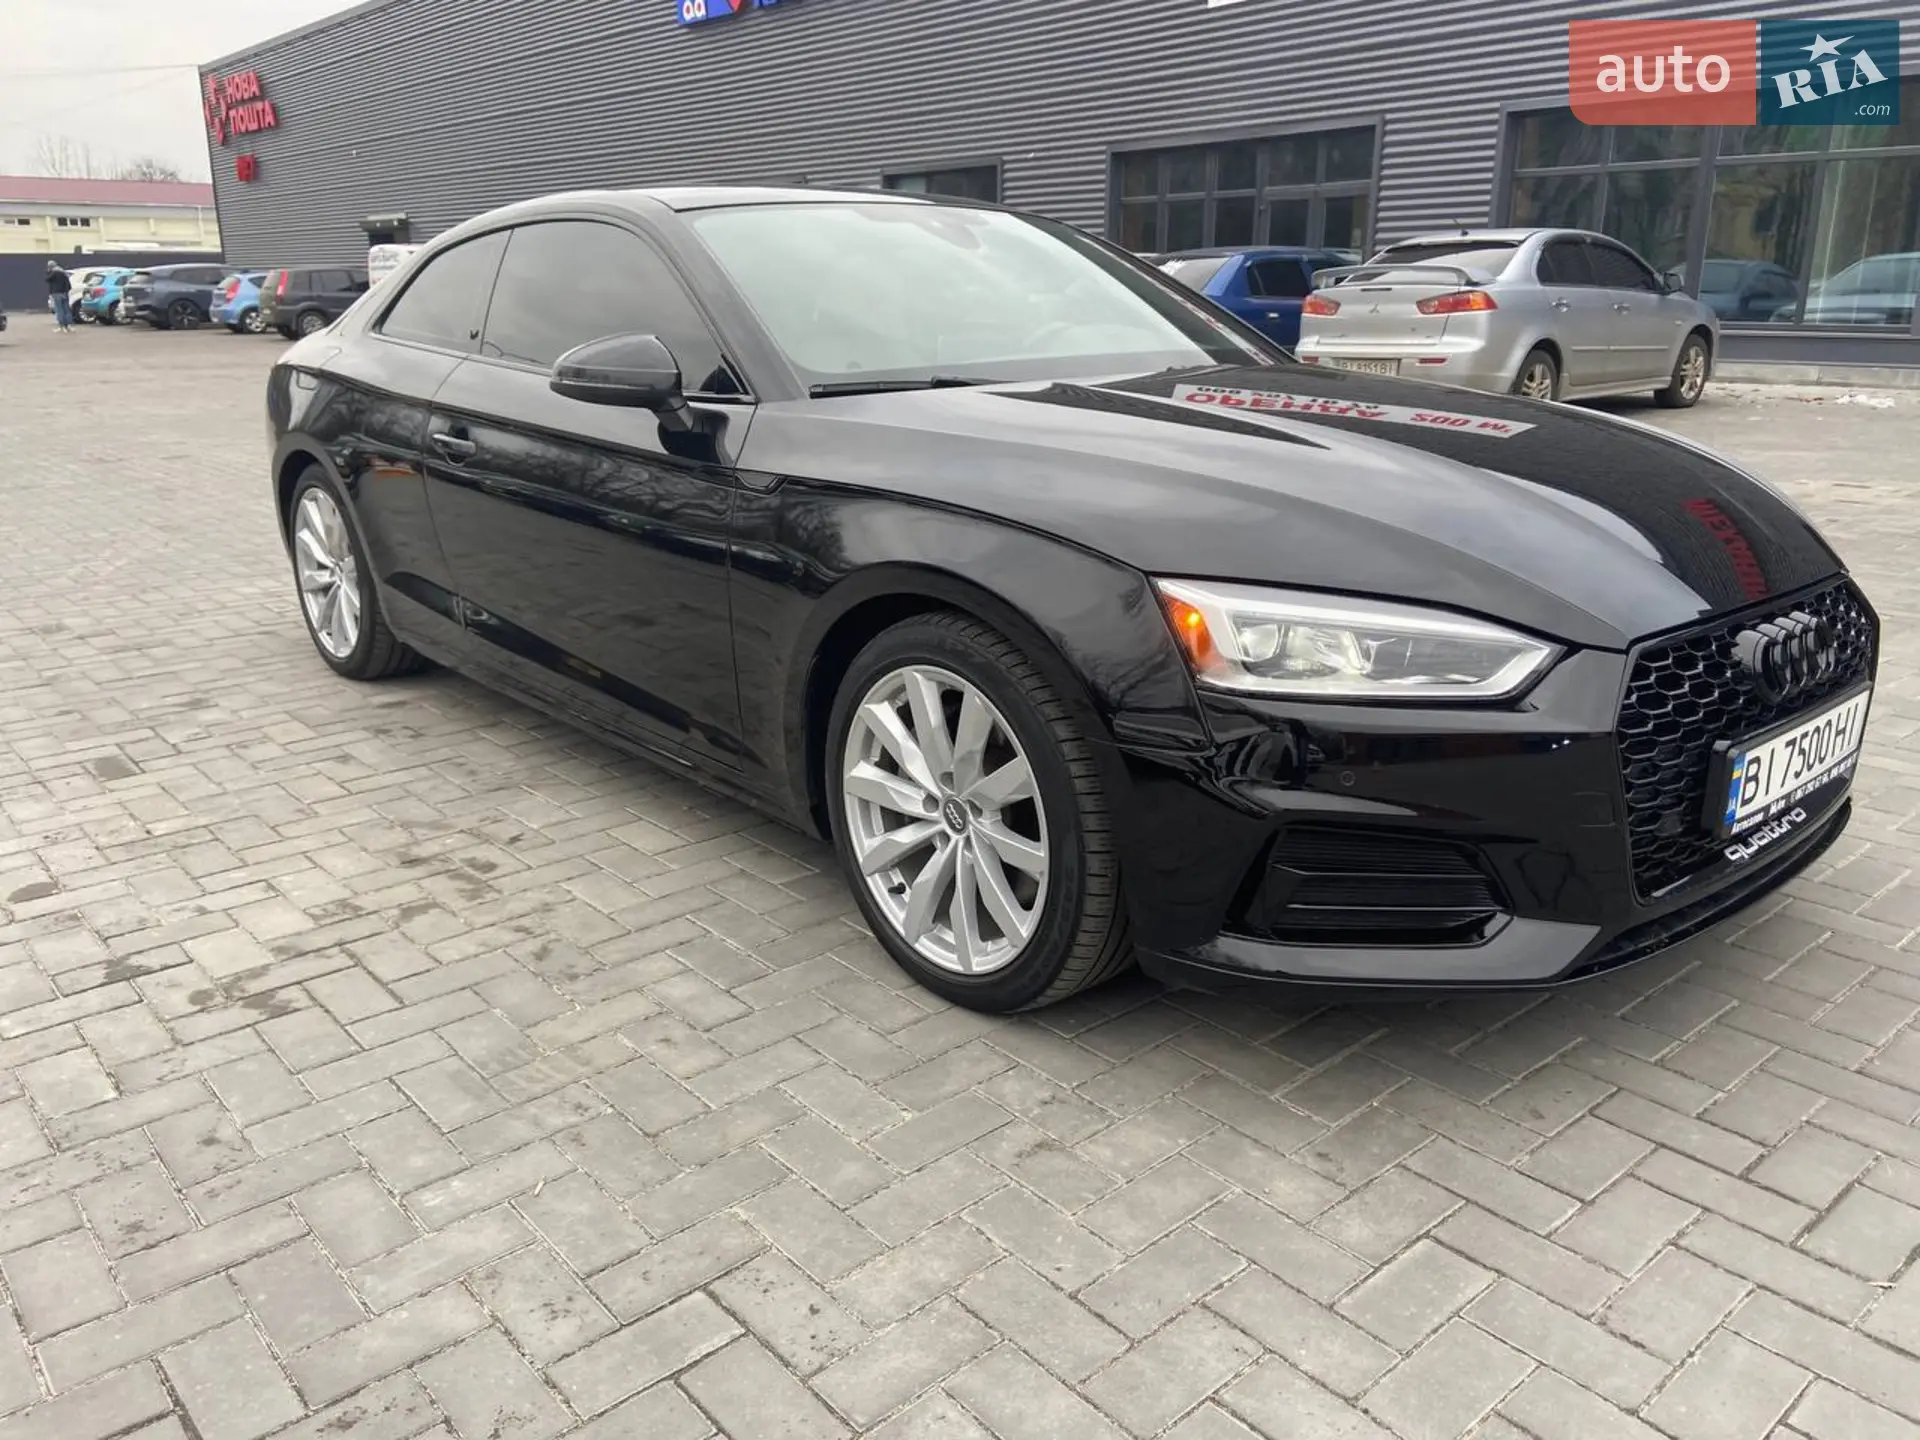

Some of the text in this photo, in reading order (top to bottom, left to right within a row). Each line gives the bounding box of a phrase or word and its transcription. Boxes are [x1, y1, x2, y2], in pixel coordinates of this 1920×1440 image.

[224, 71, 260, 103] НОВА
[228, 100, 276, 135] ПОШТА
[1723, 806, 1807, 861] quattro
